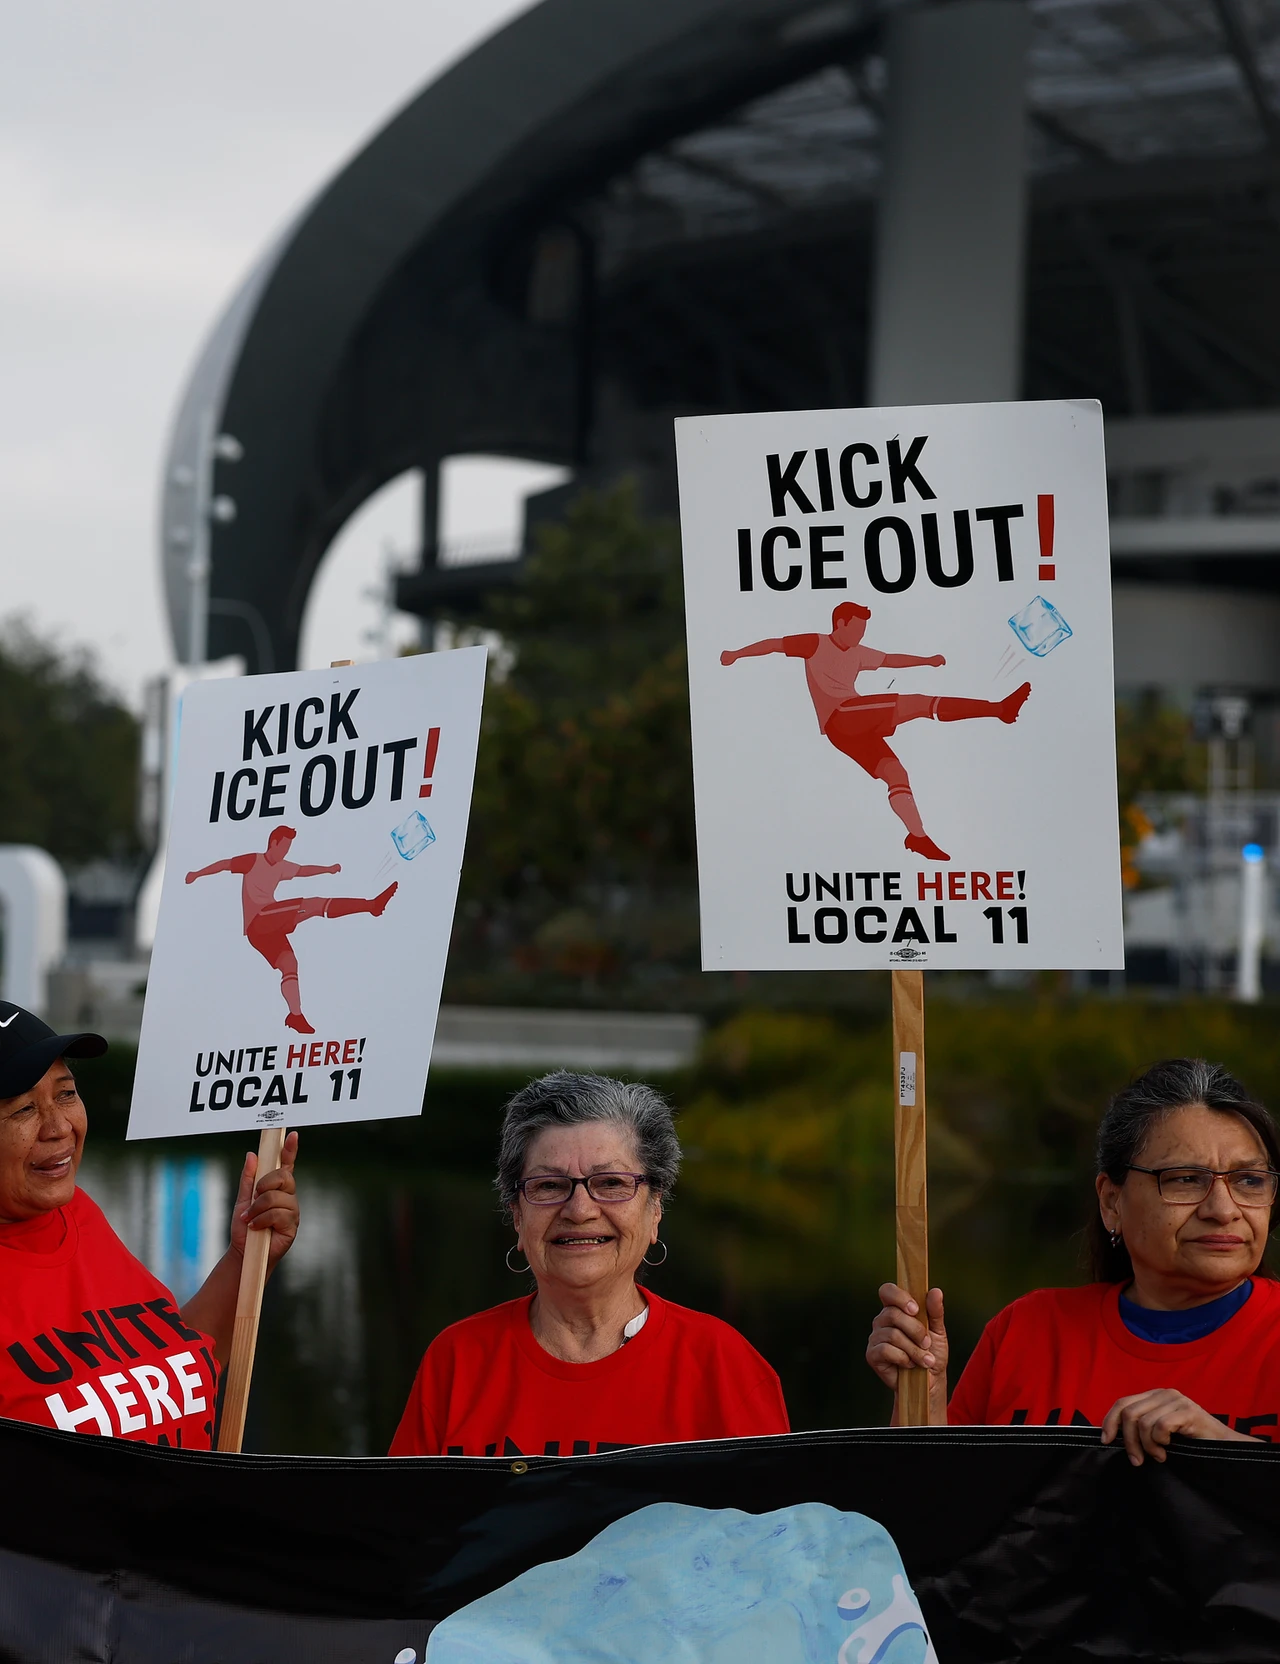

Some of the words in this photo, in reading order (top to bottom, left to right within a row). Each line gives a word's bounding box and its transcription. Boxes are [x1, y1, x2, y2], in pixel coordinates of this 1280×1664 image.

[765, 434, 938, 518] KICK
[737, 526, 848, 592] ICE
[863, 494, 1056, 594] OUT!
[242, 688, 361, 762] KICK
[209, 765, 291, 824] ICE
[299, 727, 441, 818] OUT!
[785, 872, 902, 902] UNITE
[917, 869, 1026, 902] HERE!
[787, 906, 958, 944] LOCAL
[982, 906, 1029, 944] 11
[189, 1072, 309, 1113] LOCAL
[329, 1068, 362, 1102] 11
[195, 1045, 278, 1078] UNITE
[286, 1038, 366, 1069] HERE!
[7, 1298, 202, 1384] UNITE
